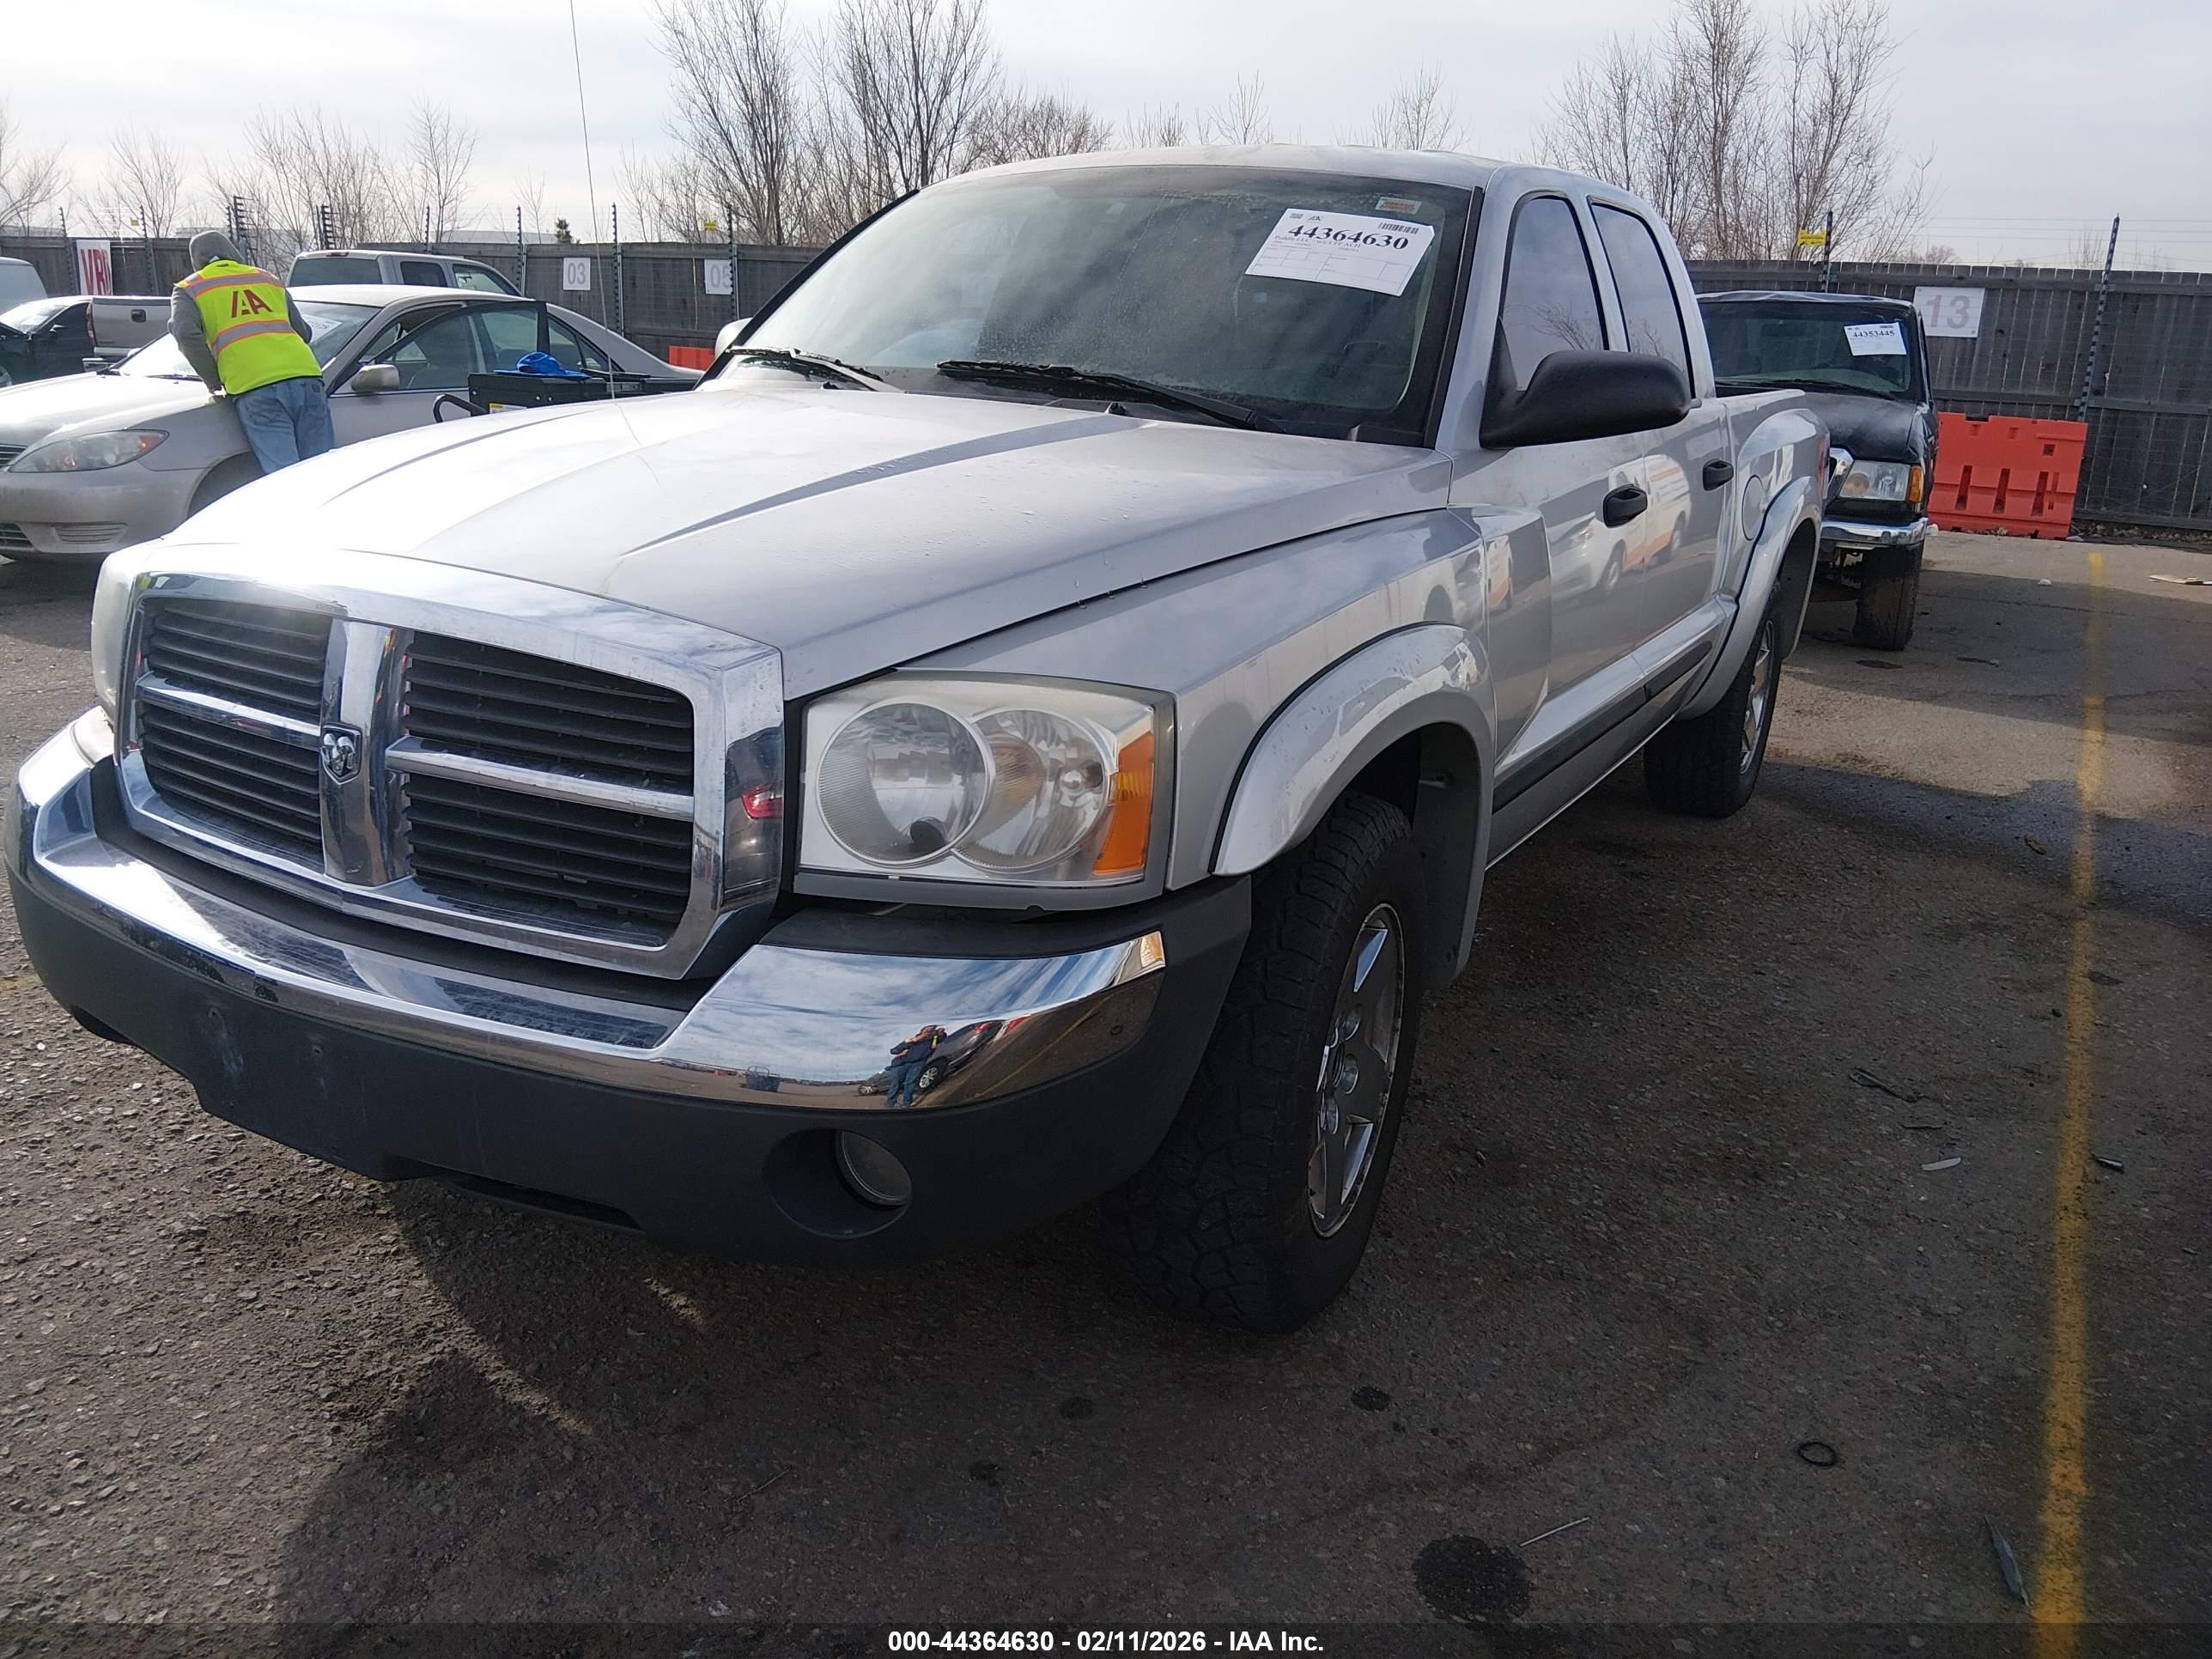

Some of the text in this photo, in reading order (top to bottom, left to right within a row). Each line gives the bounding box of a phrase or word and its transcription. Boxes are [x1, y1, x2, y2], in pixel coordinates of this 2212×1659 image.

[1288, 224, 1409, 251] 44364630
[567, 262, 586, 286] 03
[710, 264, 731, 289] 05
[1926, 295, 1971, 330] 13
[1852, 330, 1895, 338] 44353445
